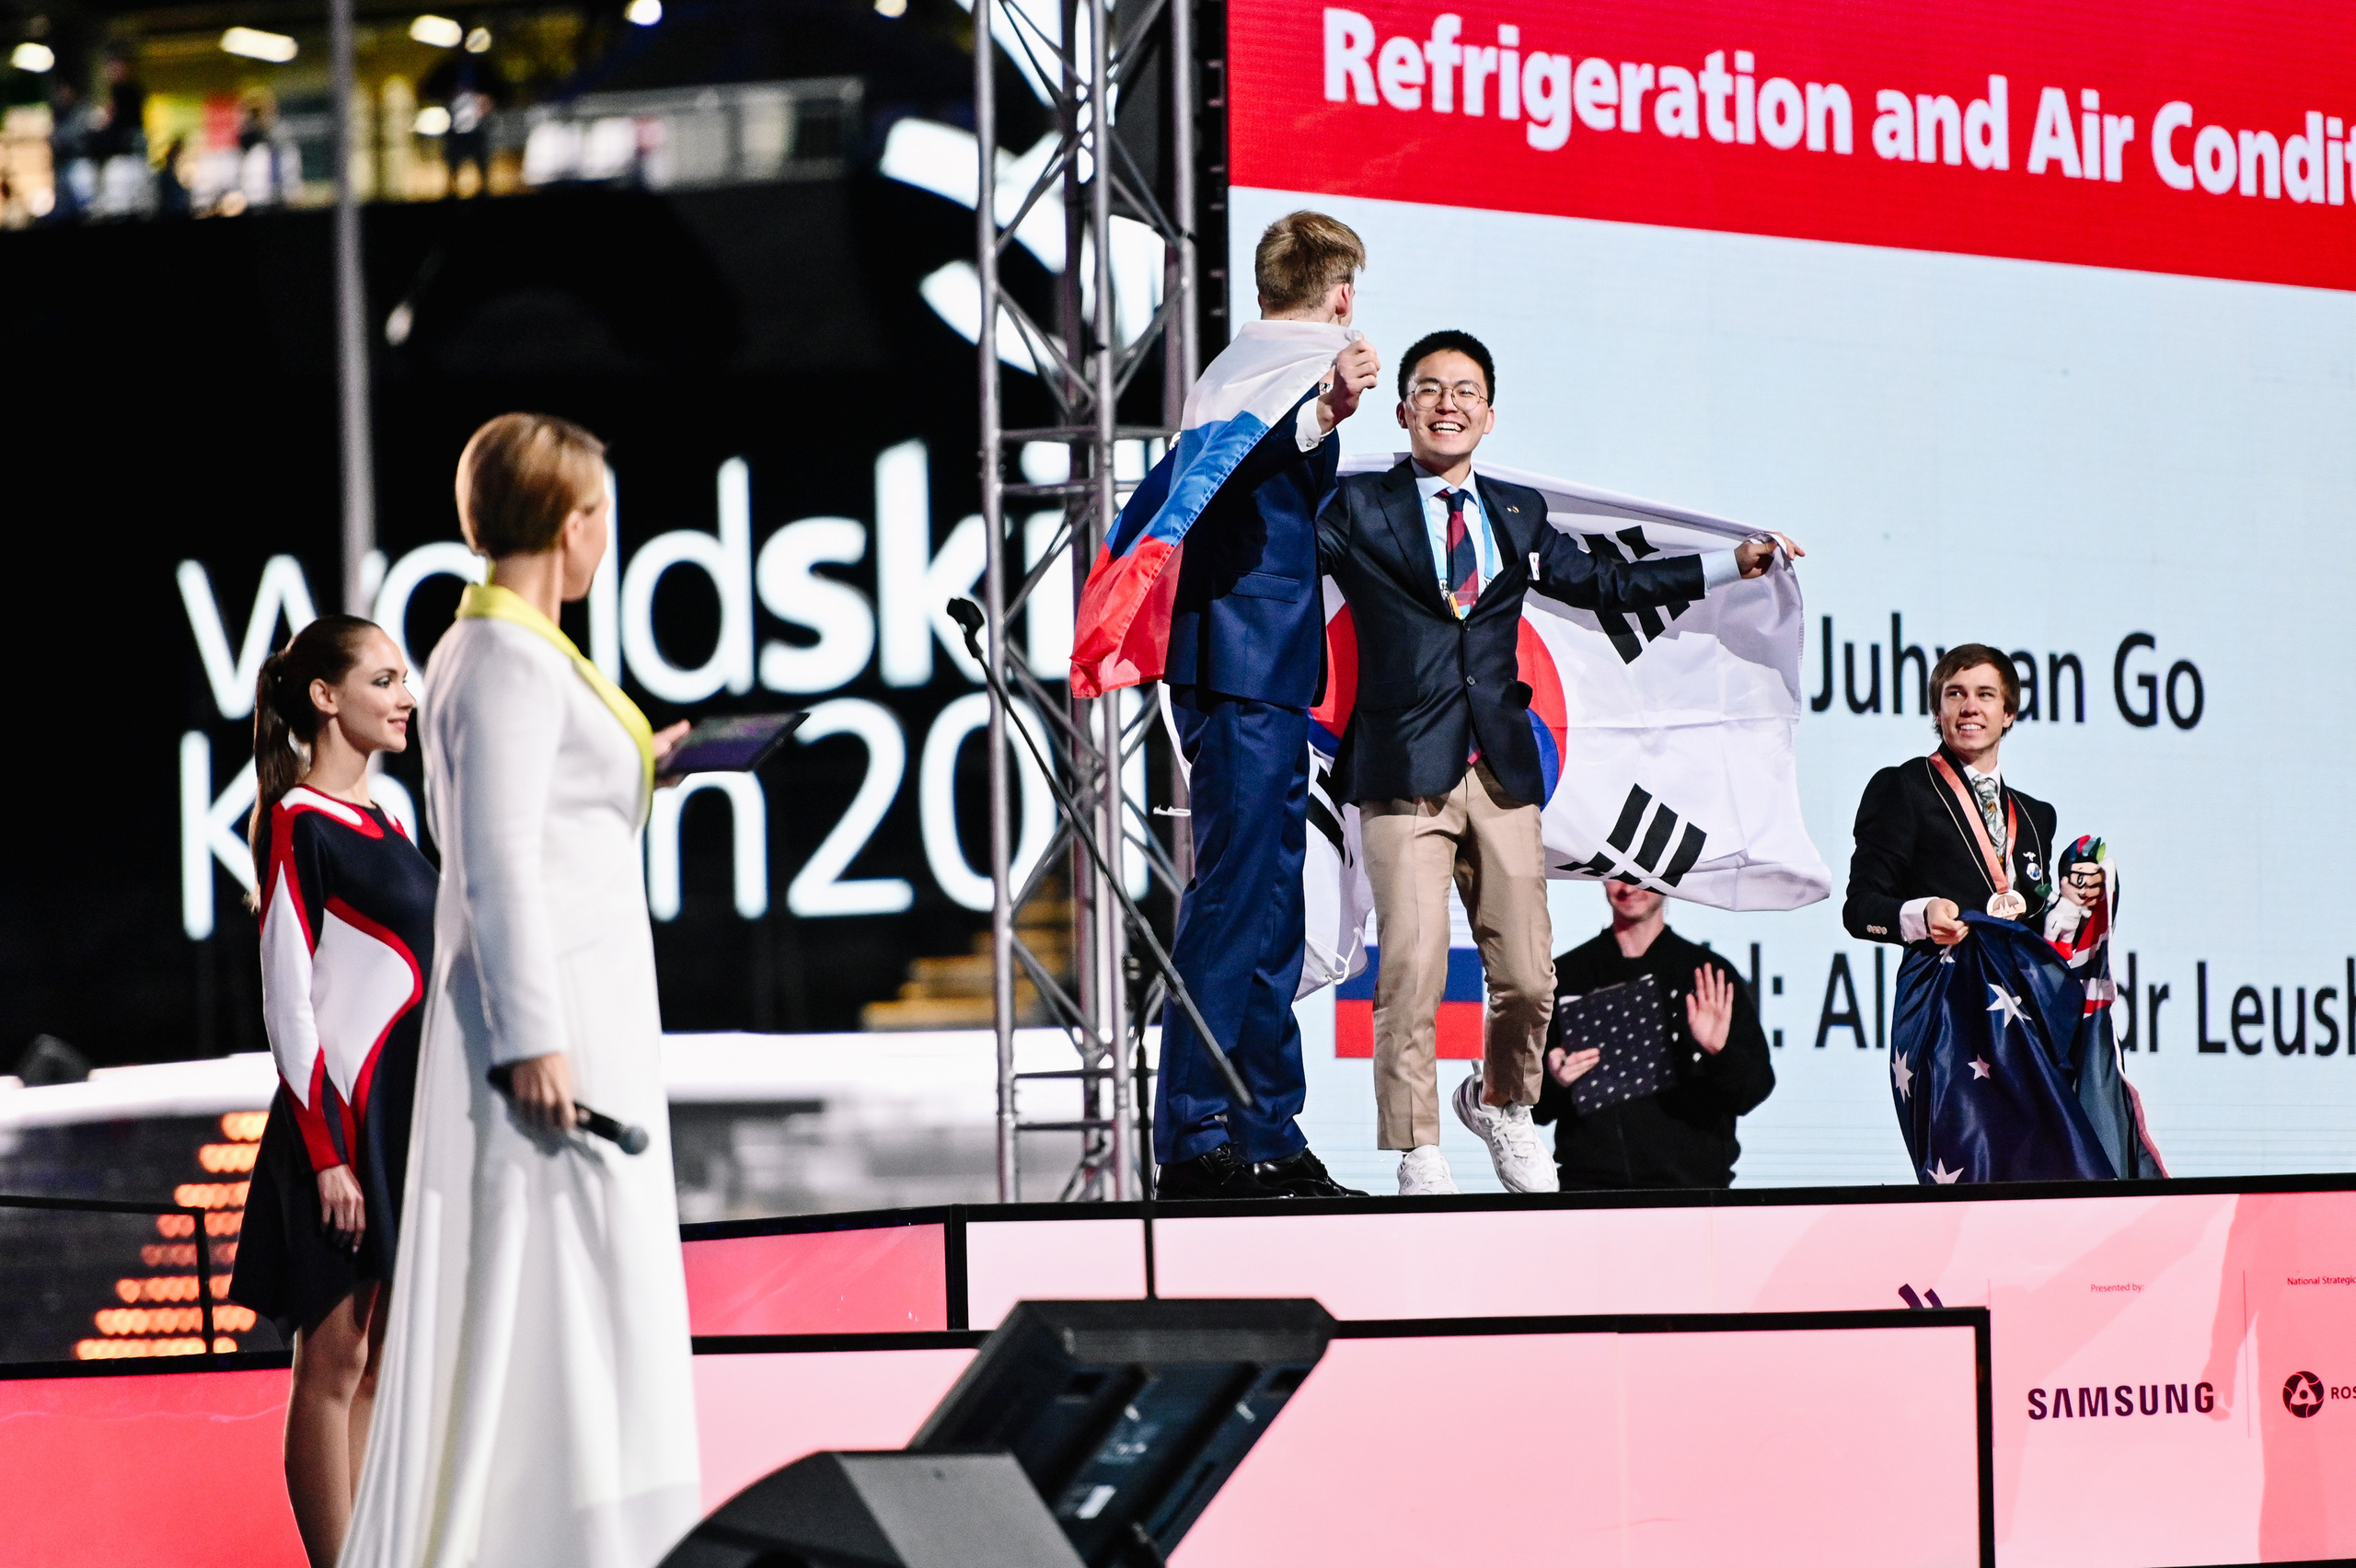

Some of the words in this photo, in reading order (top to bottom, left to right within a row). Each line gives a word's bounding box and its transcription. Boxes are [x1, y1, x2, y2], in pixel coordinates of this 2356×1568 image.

[1322, 6, 1854, 156] Refrigeration
[1872, 74, 2010, 172] and
[2027, 86, 2135, 183] Air
[1810, 612, 2085, 723] Juhan
[2113, 631, 2205, 731] Go
[2090, 1283, 2131, 1293] Presented
[2287, 1276, 2320, 1286] National
[2027, 1382, 2214, 1421] SAMSUNG
